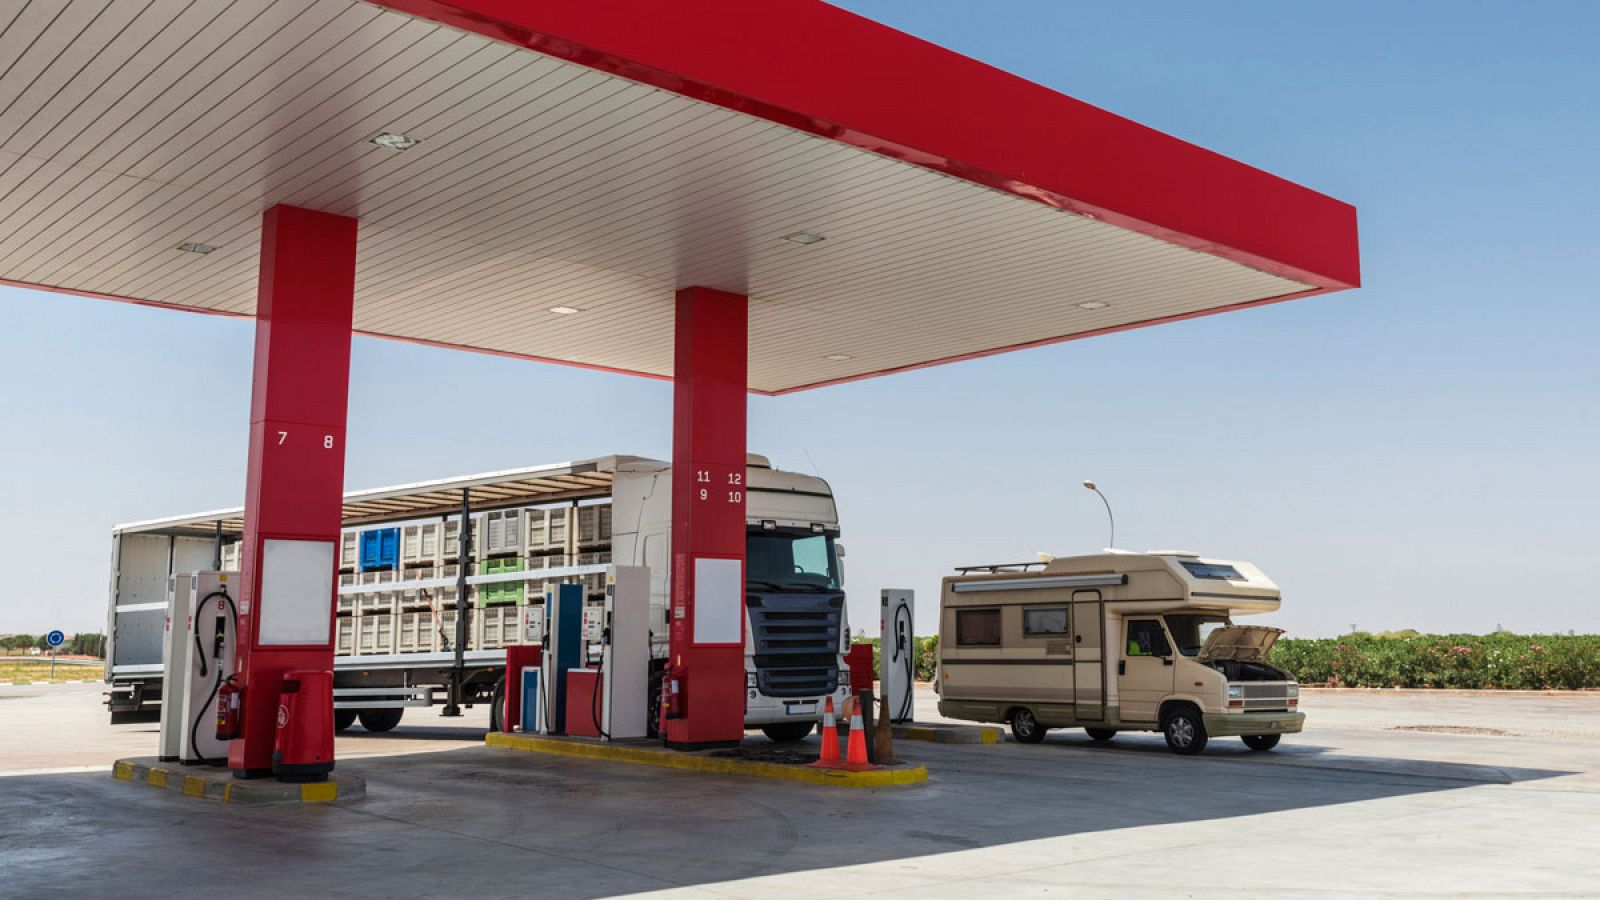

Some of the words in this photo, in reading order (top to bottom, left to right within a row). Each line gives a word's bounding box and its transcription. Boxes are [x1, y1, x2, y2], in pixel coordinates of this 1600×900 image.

[278, 431, 288, 445] 7
[323, 435, 334, 449] 8
[697, 470, 711, 482] 11
[728, 472, 742, 485] 12
[700, 488, 708, 500] 9
[728, 491, 742, 503] 10
